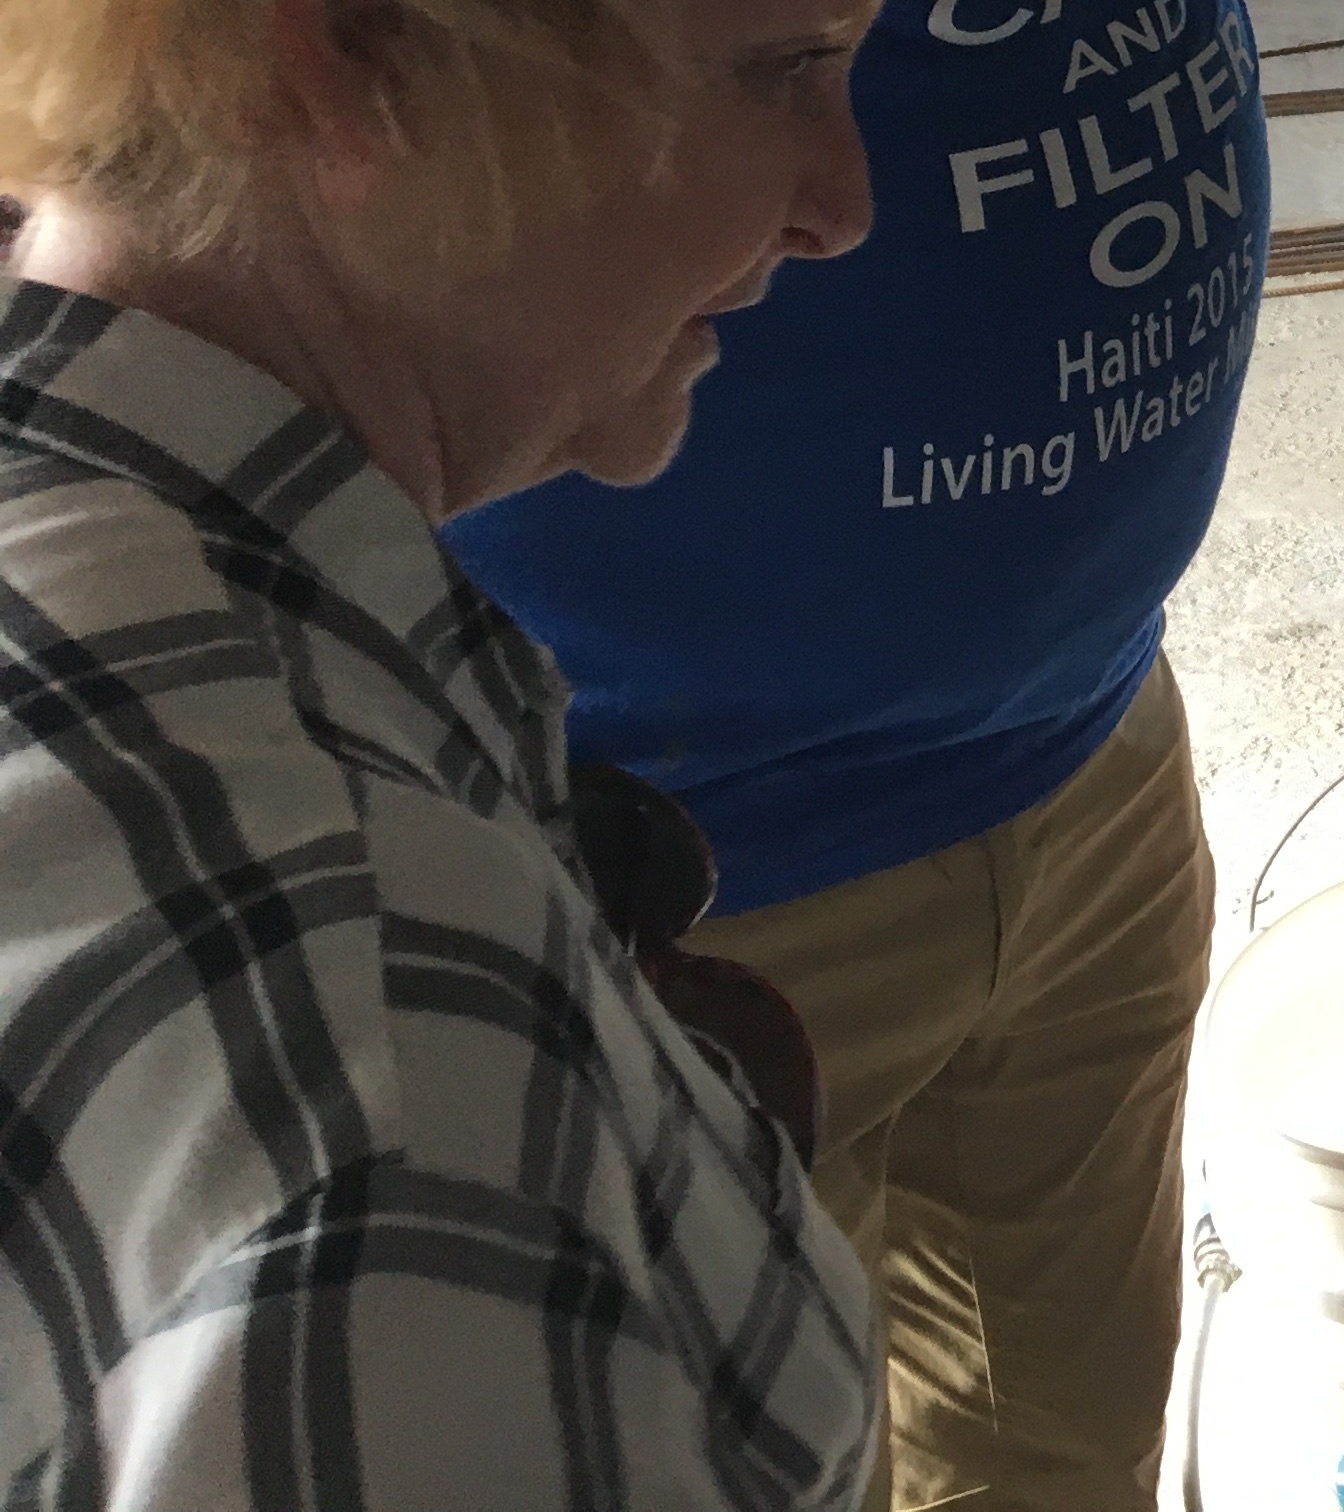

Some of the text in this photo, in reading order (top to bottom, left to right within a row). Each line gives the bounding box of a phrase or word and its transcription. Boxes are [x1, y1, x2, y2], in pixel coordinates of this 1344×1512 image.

[948, 10, 1255, 234] FILTER
[1088, 141, 1244, 289] ON
[1056, 298, 1173, 403] Haiti
[1186, 232, 1255, 348] 2015
[881, 356, 1219, 509] Living Water
